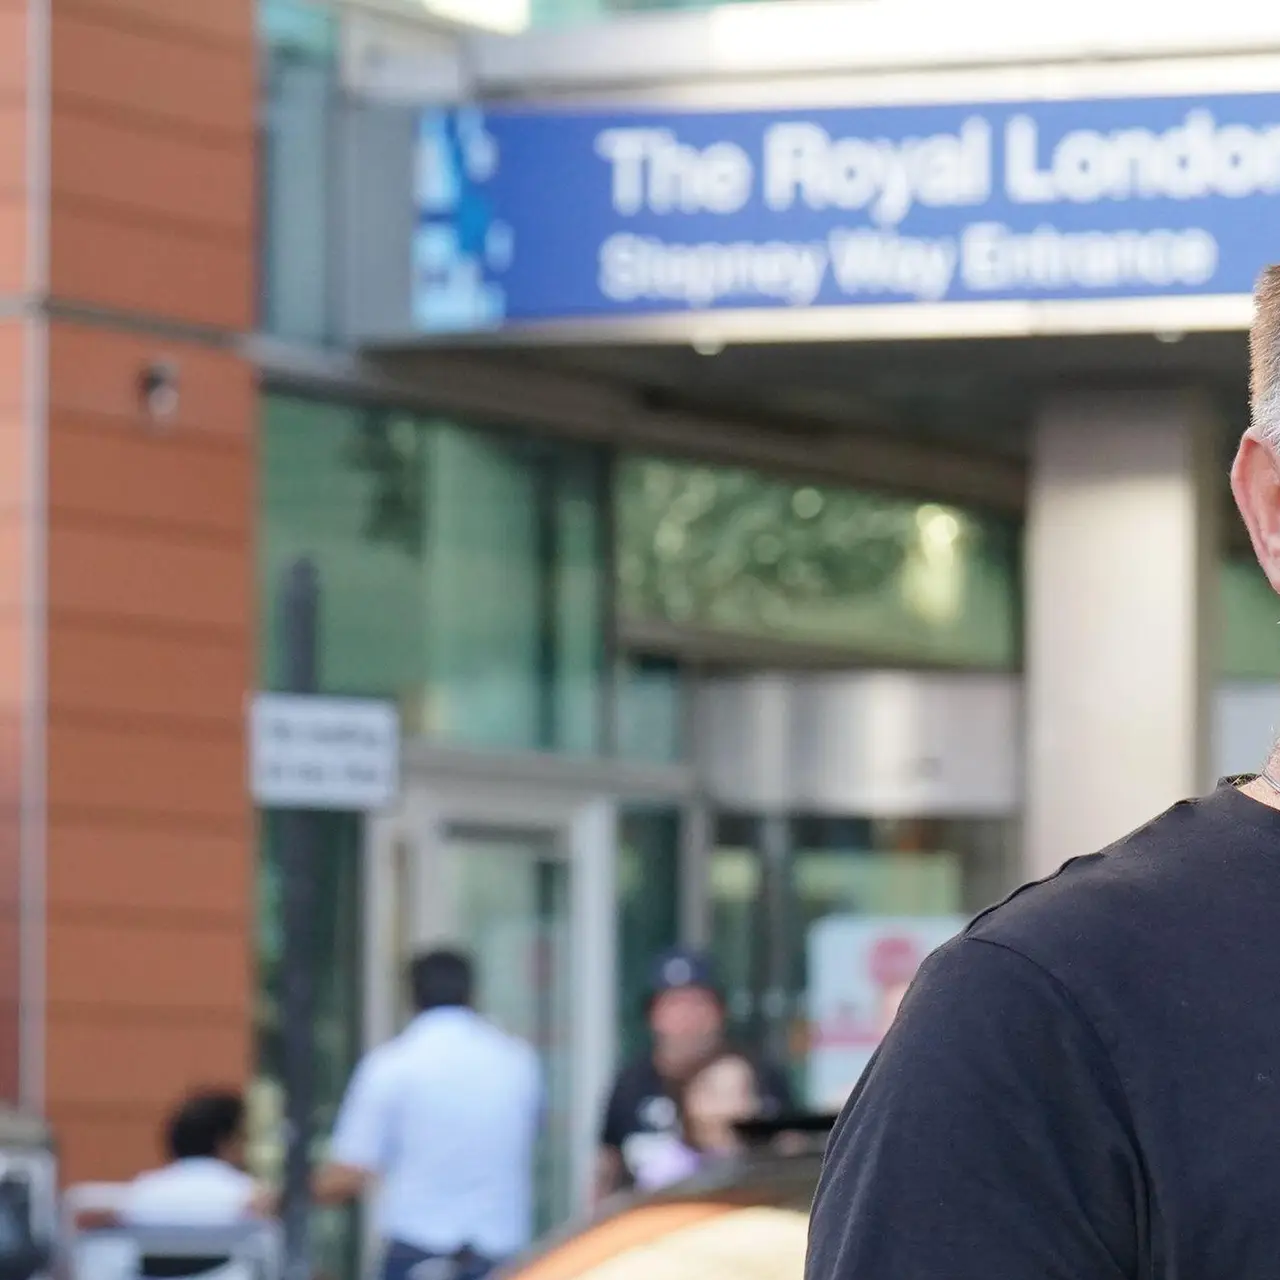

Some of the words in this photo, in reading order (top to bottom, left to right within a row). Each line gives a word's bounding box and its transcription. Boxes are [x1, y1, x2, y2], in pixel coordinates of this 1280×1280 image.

[595, 127, 753, 214] The
[763, 114, 992, 226] Royal
[828, 226, 957, 302] Way
[961, 222, 1216, 289] Entrance
